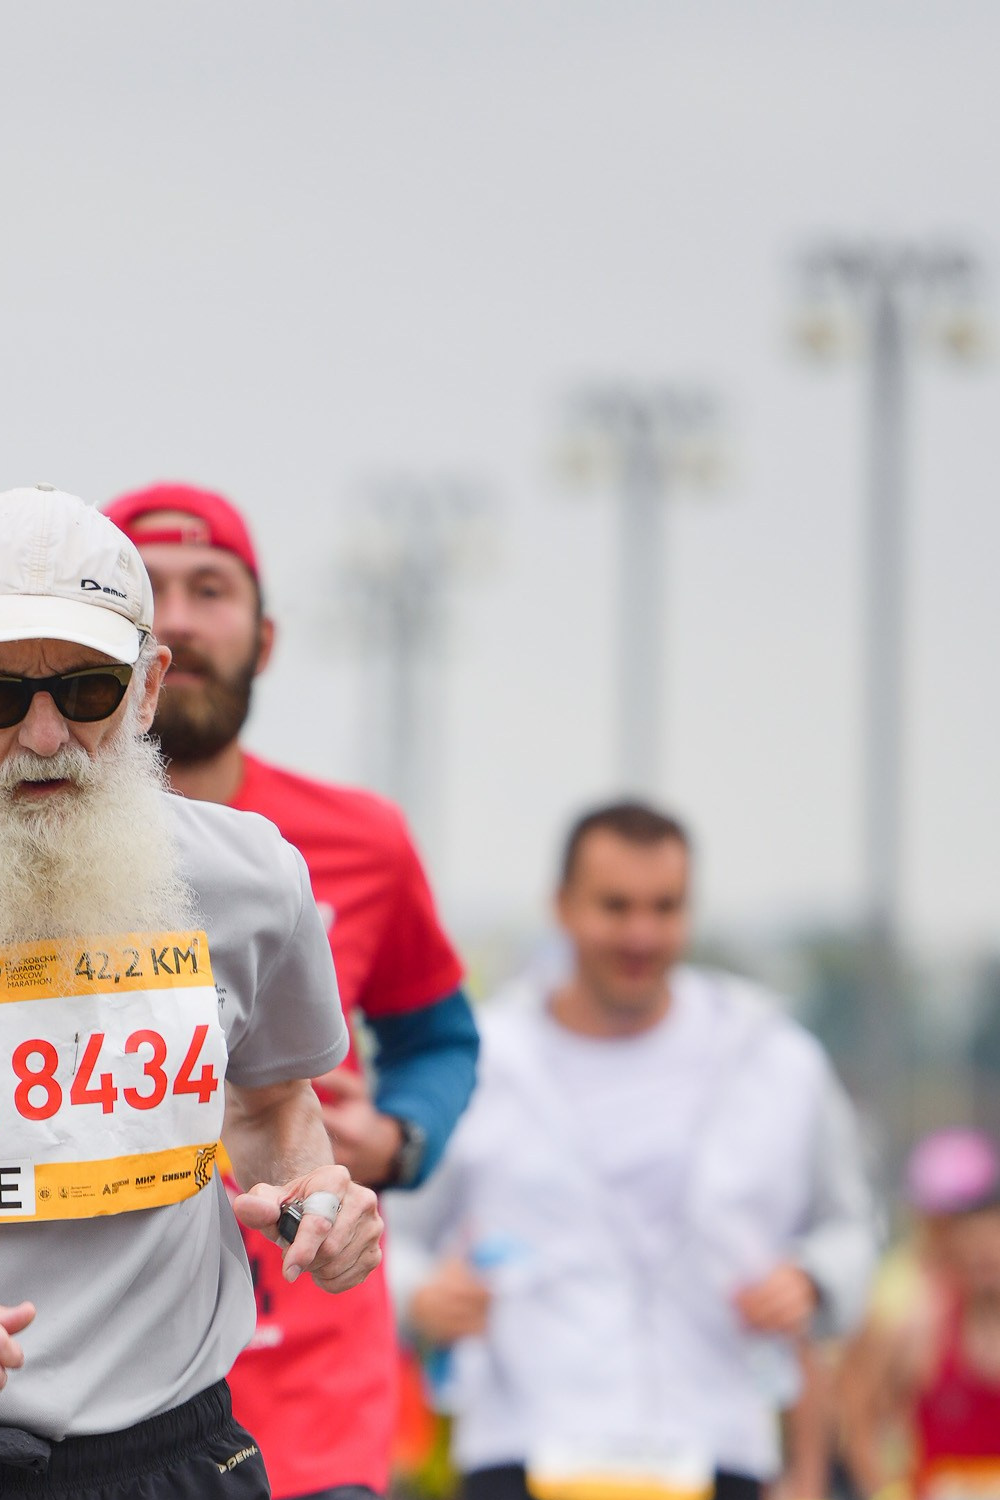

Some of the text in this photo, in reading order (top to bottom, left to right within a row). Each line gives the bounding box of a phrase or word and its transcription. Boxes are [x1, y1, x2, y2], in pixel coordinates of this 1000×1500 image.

[75, 948, 143, 984] 42,2
[6, 971, 43, 982] MOSCOW
[7, 977, 52, 989] MARATHON
